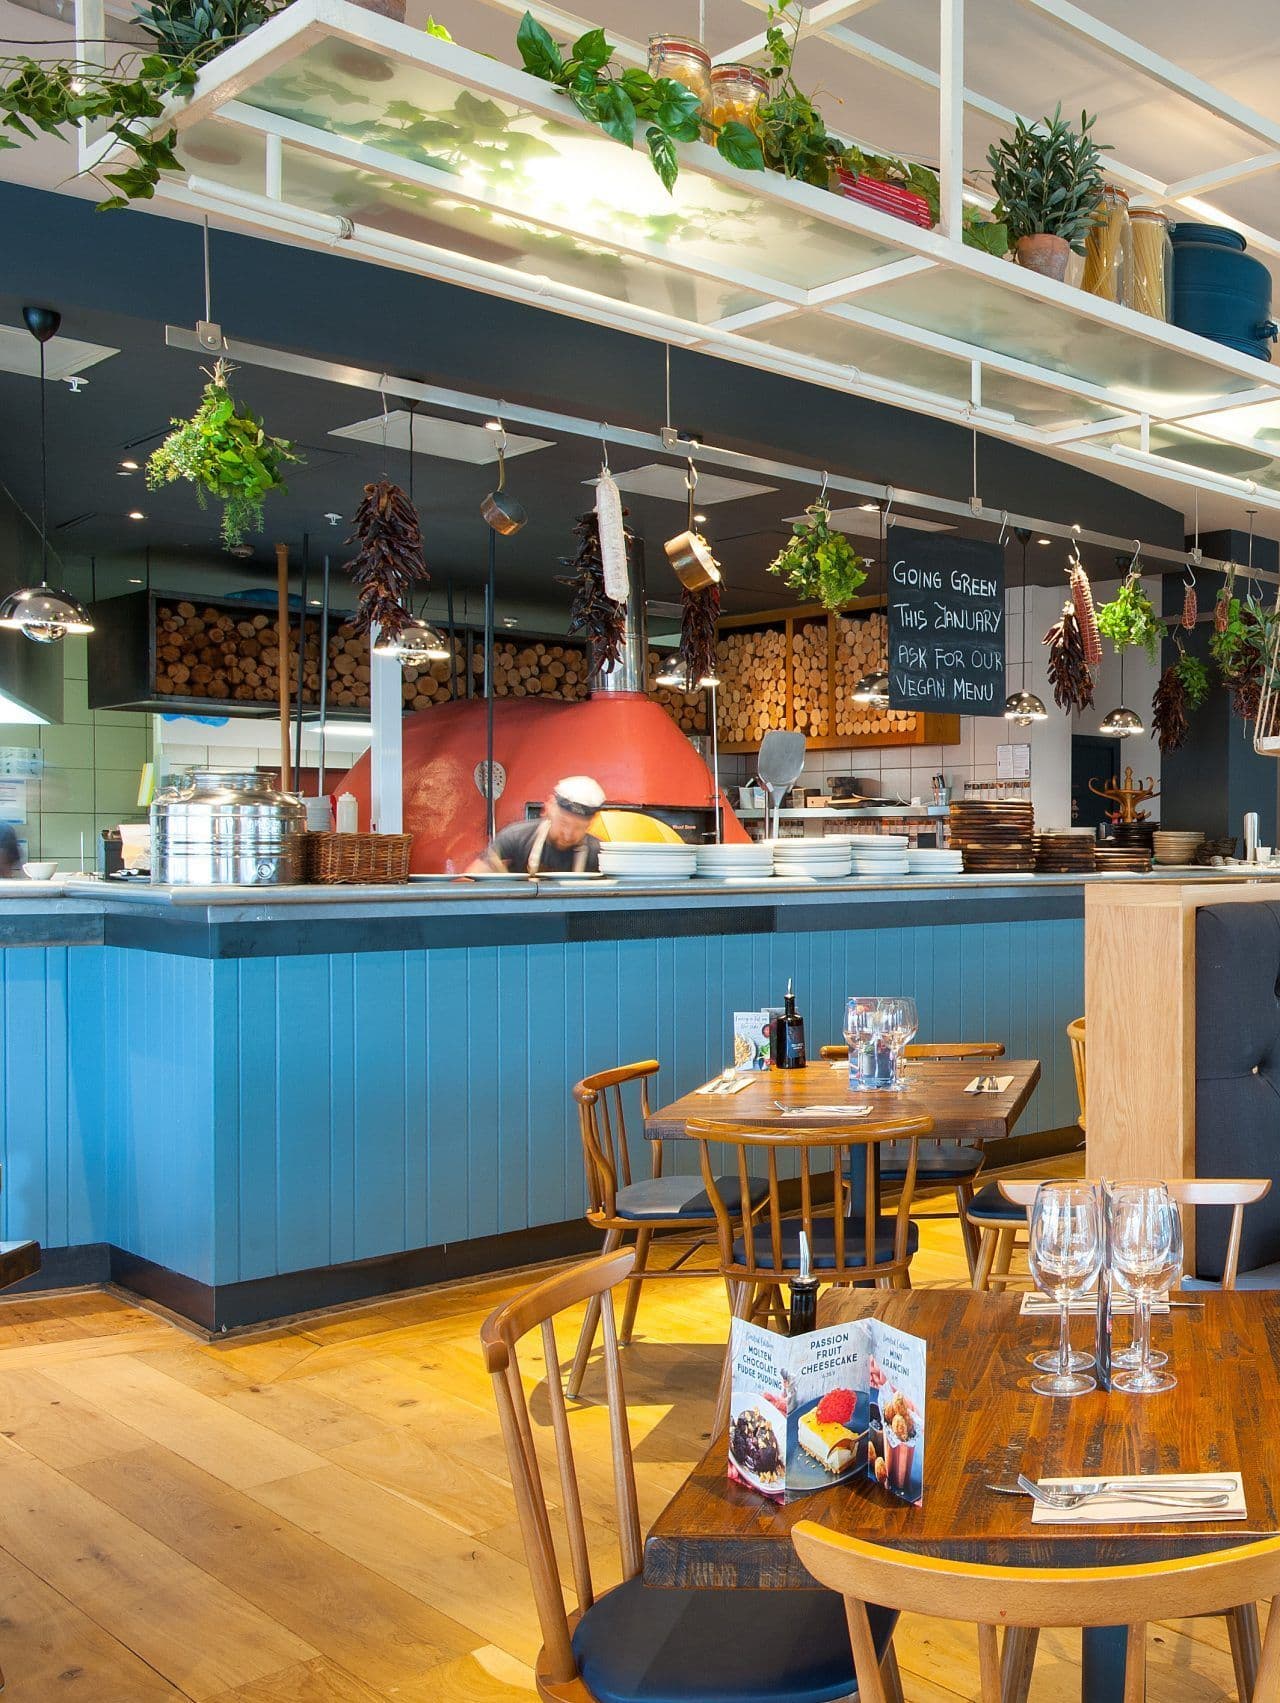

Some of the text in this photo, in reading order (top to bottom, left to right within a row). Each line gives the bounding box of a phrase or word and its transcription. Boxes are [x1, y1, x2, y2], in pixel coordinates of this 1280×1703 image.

[893, 560, 997, 597] GOING GREEN
[893, 601, 1001, 633] THIS JANUARY
[898, 644, 1003, 672] ASK FOR OUR
[895, 675, 994, 701] VEGAN MENU
[748, 1345, 772, 1362] MOLTEN
[810, 1333, 849, 1350] PASSION
[816, 1345, 842, 1360] FRUIT
[742, 1354, 777, 1376] CHOCOLATE
[801, 1353, 858, 1375] CHEESECAKE
[737, 1363, 756, 1378] FUDGE
[757, 1371, 782, 1390] PUDDING
